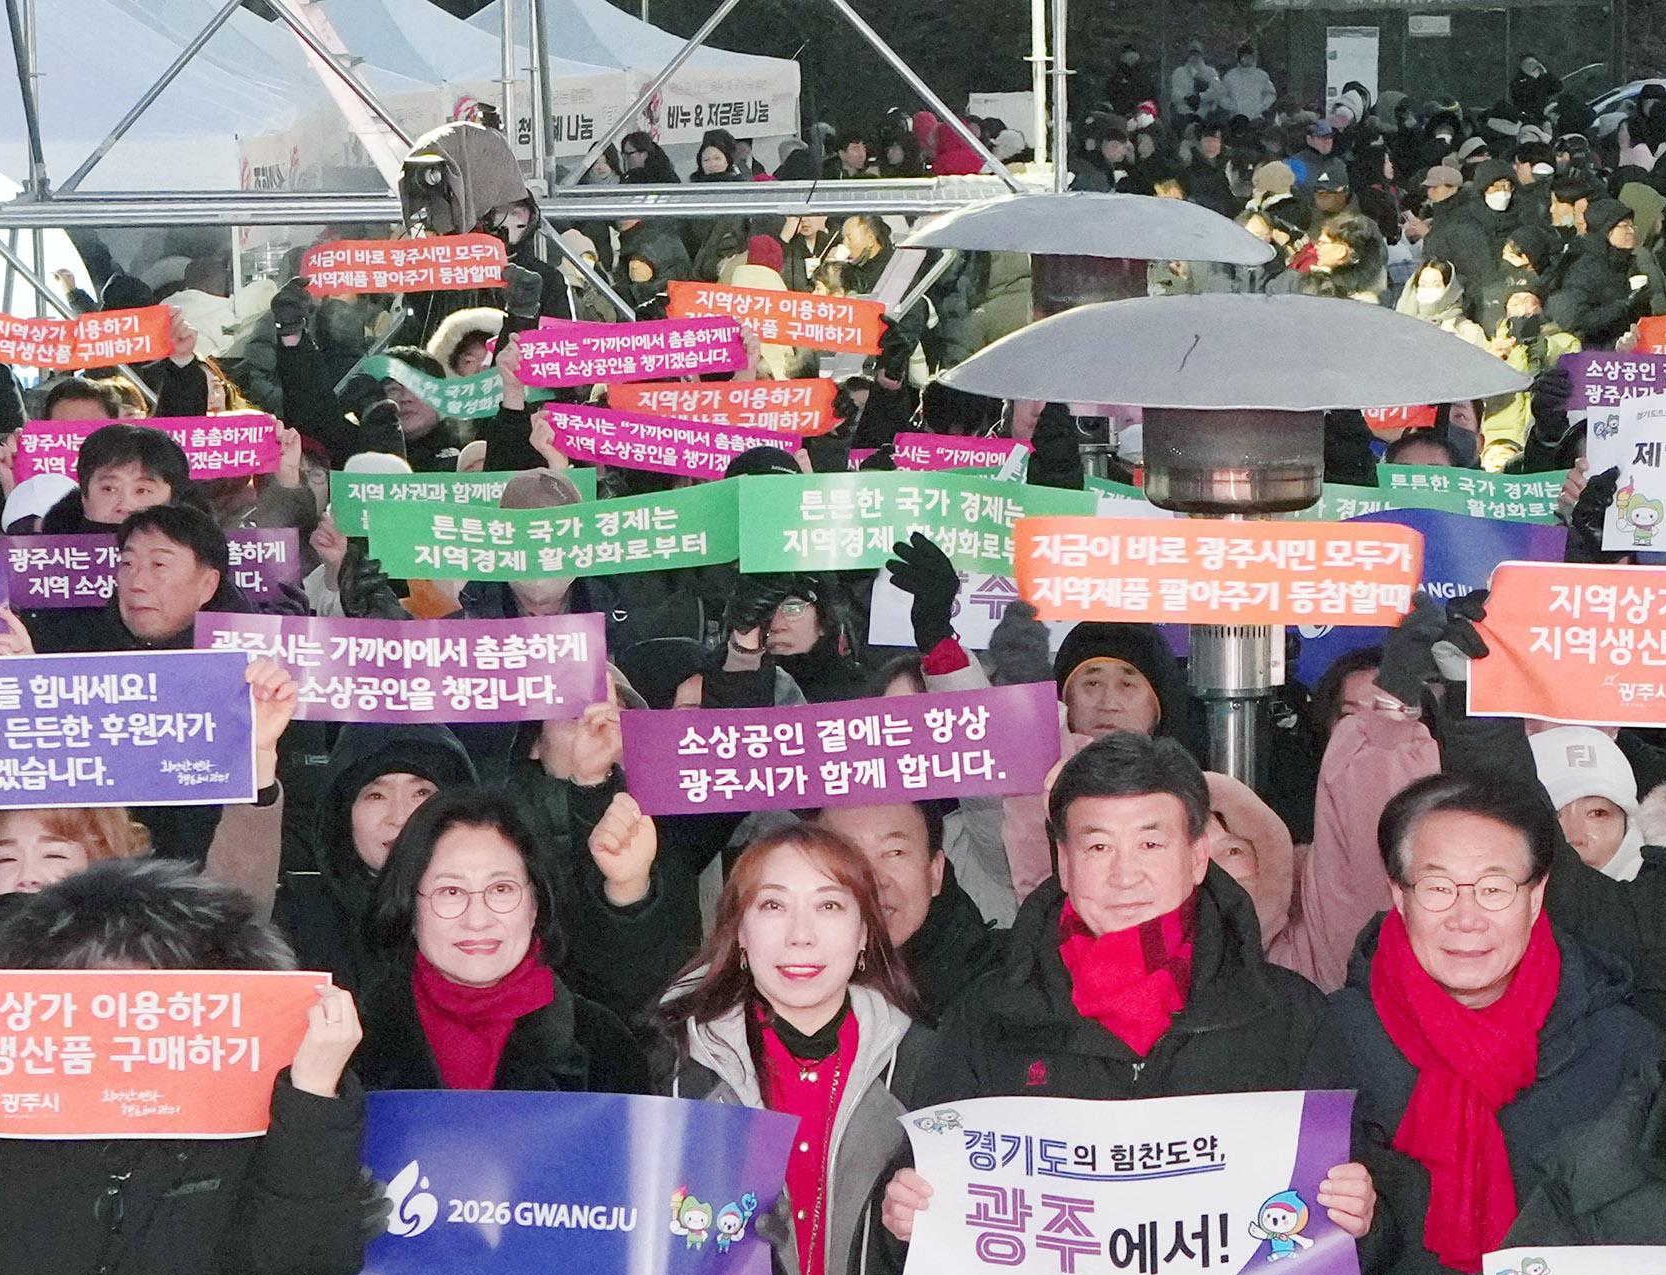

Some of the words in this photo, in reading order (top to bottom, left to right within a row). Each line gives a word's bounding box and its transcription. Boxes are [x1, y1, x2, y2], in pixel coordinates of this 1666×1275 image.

[668, 106, 690, 128] 비누
[694, 107, 703, 126] &
[707, 102, 742, 126] 저금통
[746, 101, 769, 123] 나눔
[308, 248, 351, 266] 지금이
[356, 247, 386, 265] 바로
[391, 247, 451, 265] 광주시민
[455, 245, 499, 262] 모두가
[308, 269, 368, 289] 지역제품
[373, 267, 434, 286] 팔아주기
[439, 264, 501, 284] 동참할때
[520, 340, 579, 362] 광주시는
[531, 362, 561, 379] 지역
[565, 357, 636, 377] 소상공인을
[432, 516, 516, 541] 튼튼한
[528, 515, 586, 539] 국가
[594, 507, 678, 535] 경제는
[414, 545, 527, 573] 지역경제
[539, 533, 706, 571] 활성화로부터
[1032, 535, 1121, 565] 지금이
[1129, 537, 1189, 565] 바로
[1195, 538, 1315, 570] 광주시민
[1324, 538, 1412, 571] 모두가
[1032, 579, 1152, 608] 지역제품
[1159, 582, 1280, 611] 팔아주기
[1287, 584, 1408, 613] 동참할때
[330, 632, 467, 665] 가까이에서
[473, 630, 588, 668] 촘촘하게
[29, 672, 158, 706] 힘내세요!
[298, 677, 435, 710] 소상공인을
[5, 718, 88, 748] 든든한
[99, 711, 216, 746] 후원자가
[677, 723, 804, 758] 소상공인
[818, 715, 914, 751] 곁에는
[925, 708, 988, 742] 항상
[678, 764, 807, 803] 광주시가
[821, 758, 885, 794] 함께
[898, 749, 1007, 788] 합니다.
[92, 992, 242, 1029] 이용하기
[110, 1034, 260, 1072] 구매하기
[0, 1093, 59, 1113] 광주시
[963, 1130, 1099, 1175] 경기도의
[1110, 1137, 1225, 1171] 힘찬도약,
[448, 1199, 509, 1225] 2026
[513, 1199, 637, 1233] GWANGJU
